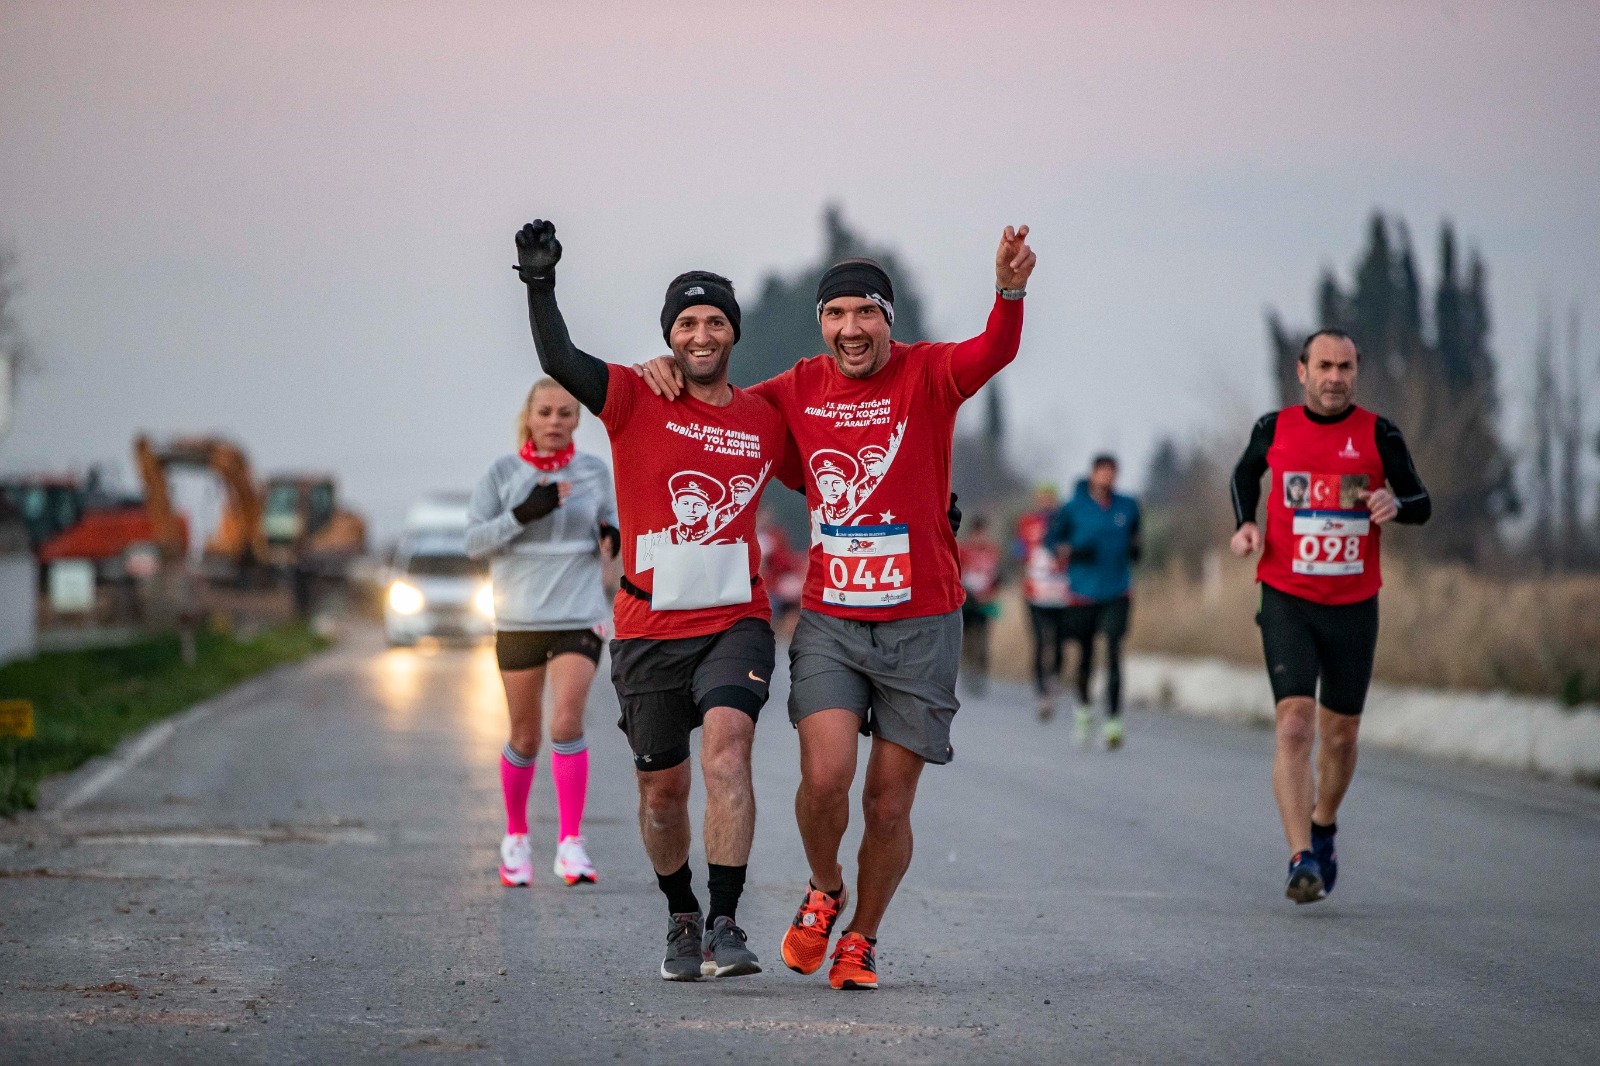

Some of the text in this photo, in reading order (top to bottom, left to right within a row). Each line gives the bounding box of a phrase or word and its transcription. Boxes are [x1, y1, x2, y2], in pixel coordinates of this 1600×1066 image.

[804, 406, 837, 418] KUBİLAY
[872, 416, 890, 425] 2021
[666, 421, 760, 449] KUBİLAY YOL KOŞUSU
[690, 422, 700, 431] 15.
[702, 426, 724, 435] ŞEHİT
[715, 446, 745, 456] ARALIK
[1299, 535, 1360, 563] 098
[829, 557, 904, 589] 044
